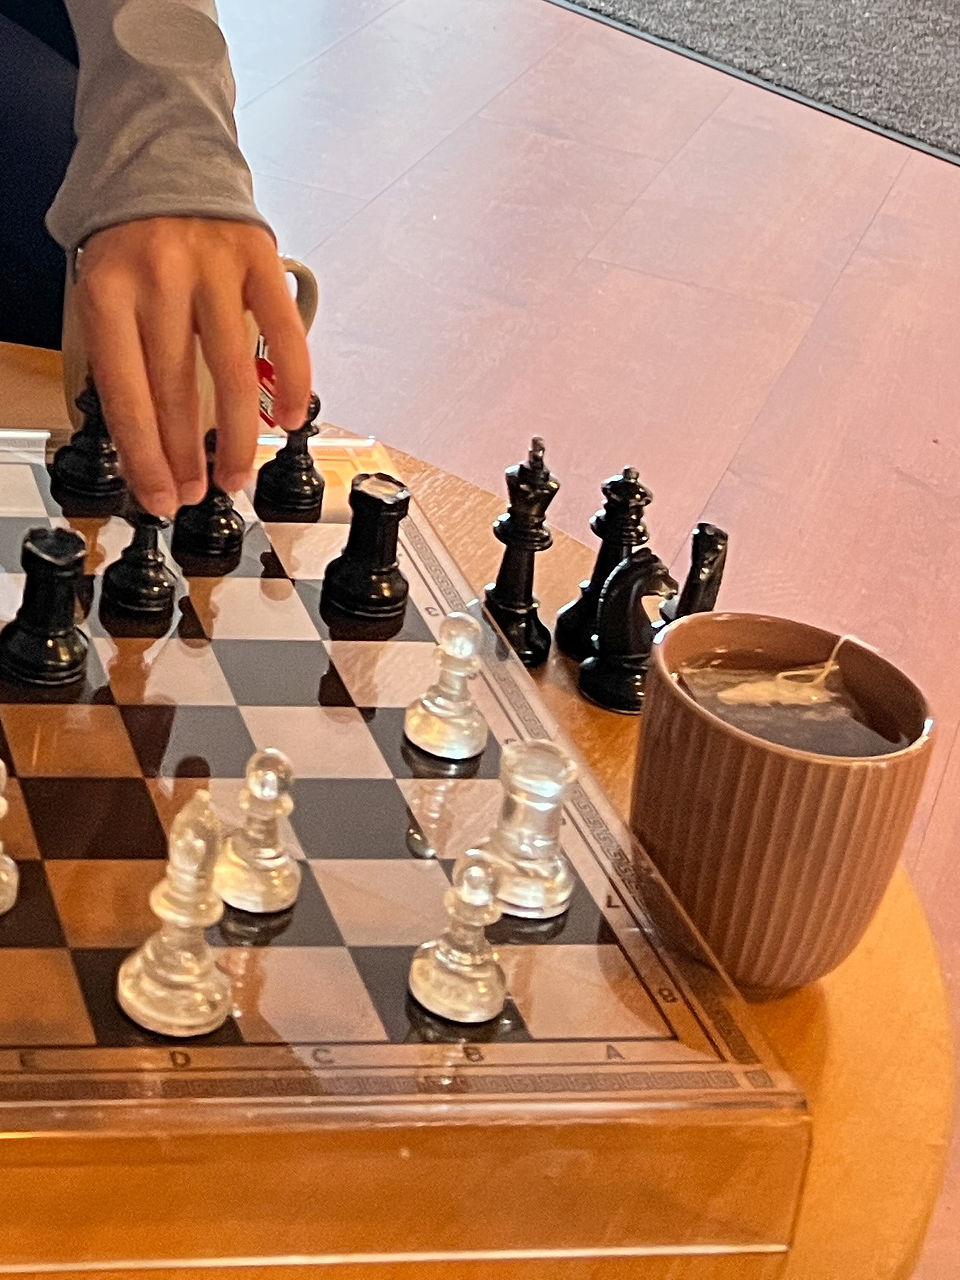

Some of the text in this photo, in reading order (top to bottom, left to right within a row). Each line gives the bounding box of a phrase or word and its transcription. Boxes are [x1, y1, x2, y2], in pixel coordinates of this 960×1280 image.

[169, 1050, 190, 1067] D
[311, 1047, 334, 1065] C
[463, 1046, 484, 1062] B
[606, 1044, 625, 1060] A
